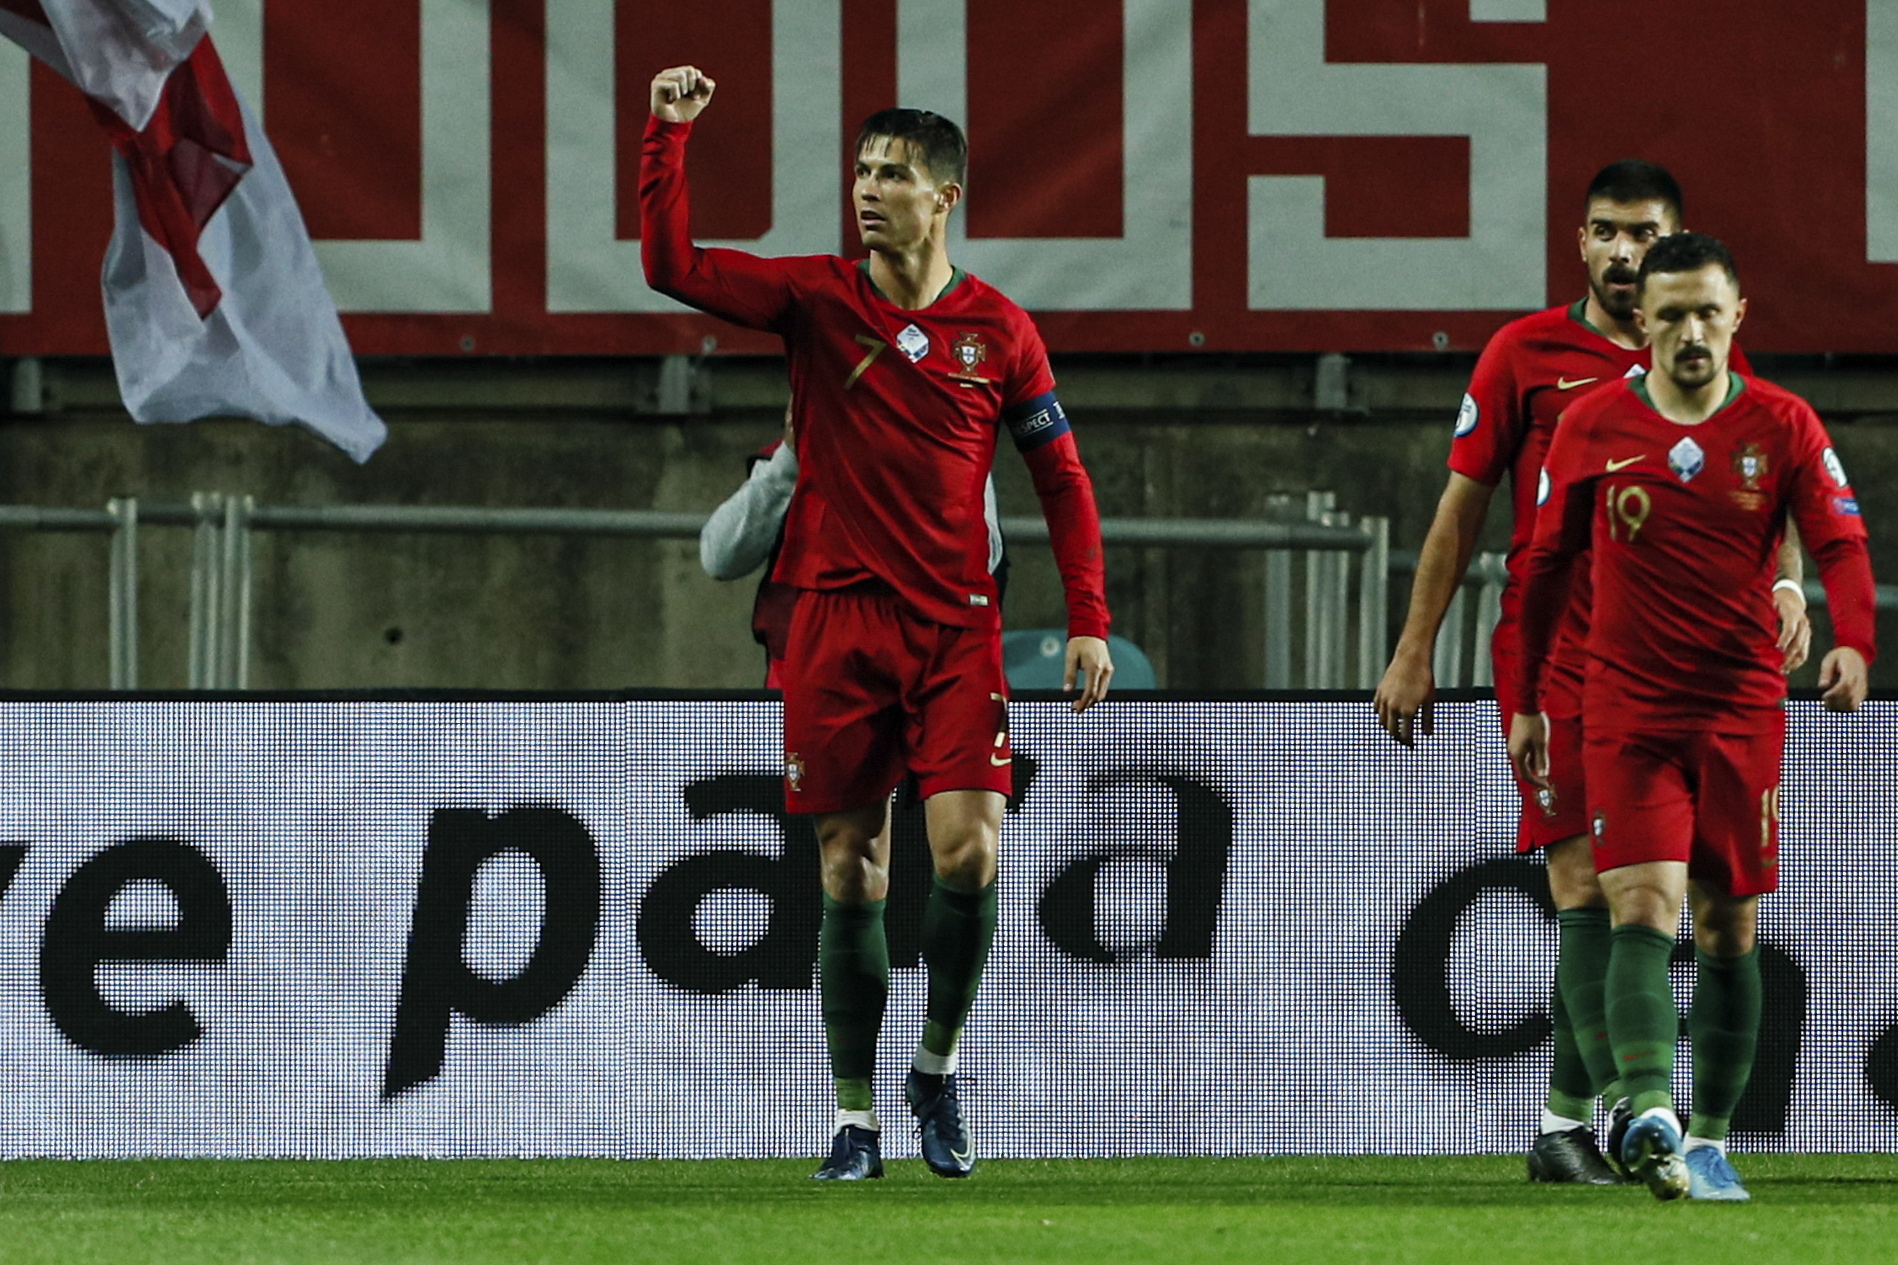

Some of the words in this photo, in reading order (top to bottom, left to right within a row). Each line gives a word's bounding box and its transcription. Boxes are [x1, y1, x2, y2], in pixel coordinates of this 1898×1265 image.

[844, 334, 886, 389] 7
[1606, 484, 1651, 542] 19
[382, 755, 1233, 1104] para
